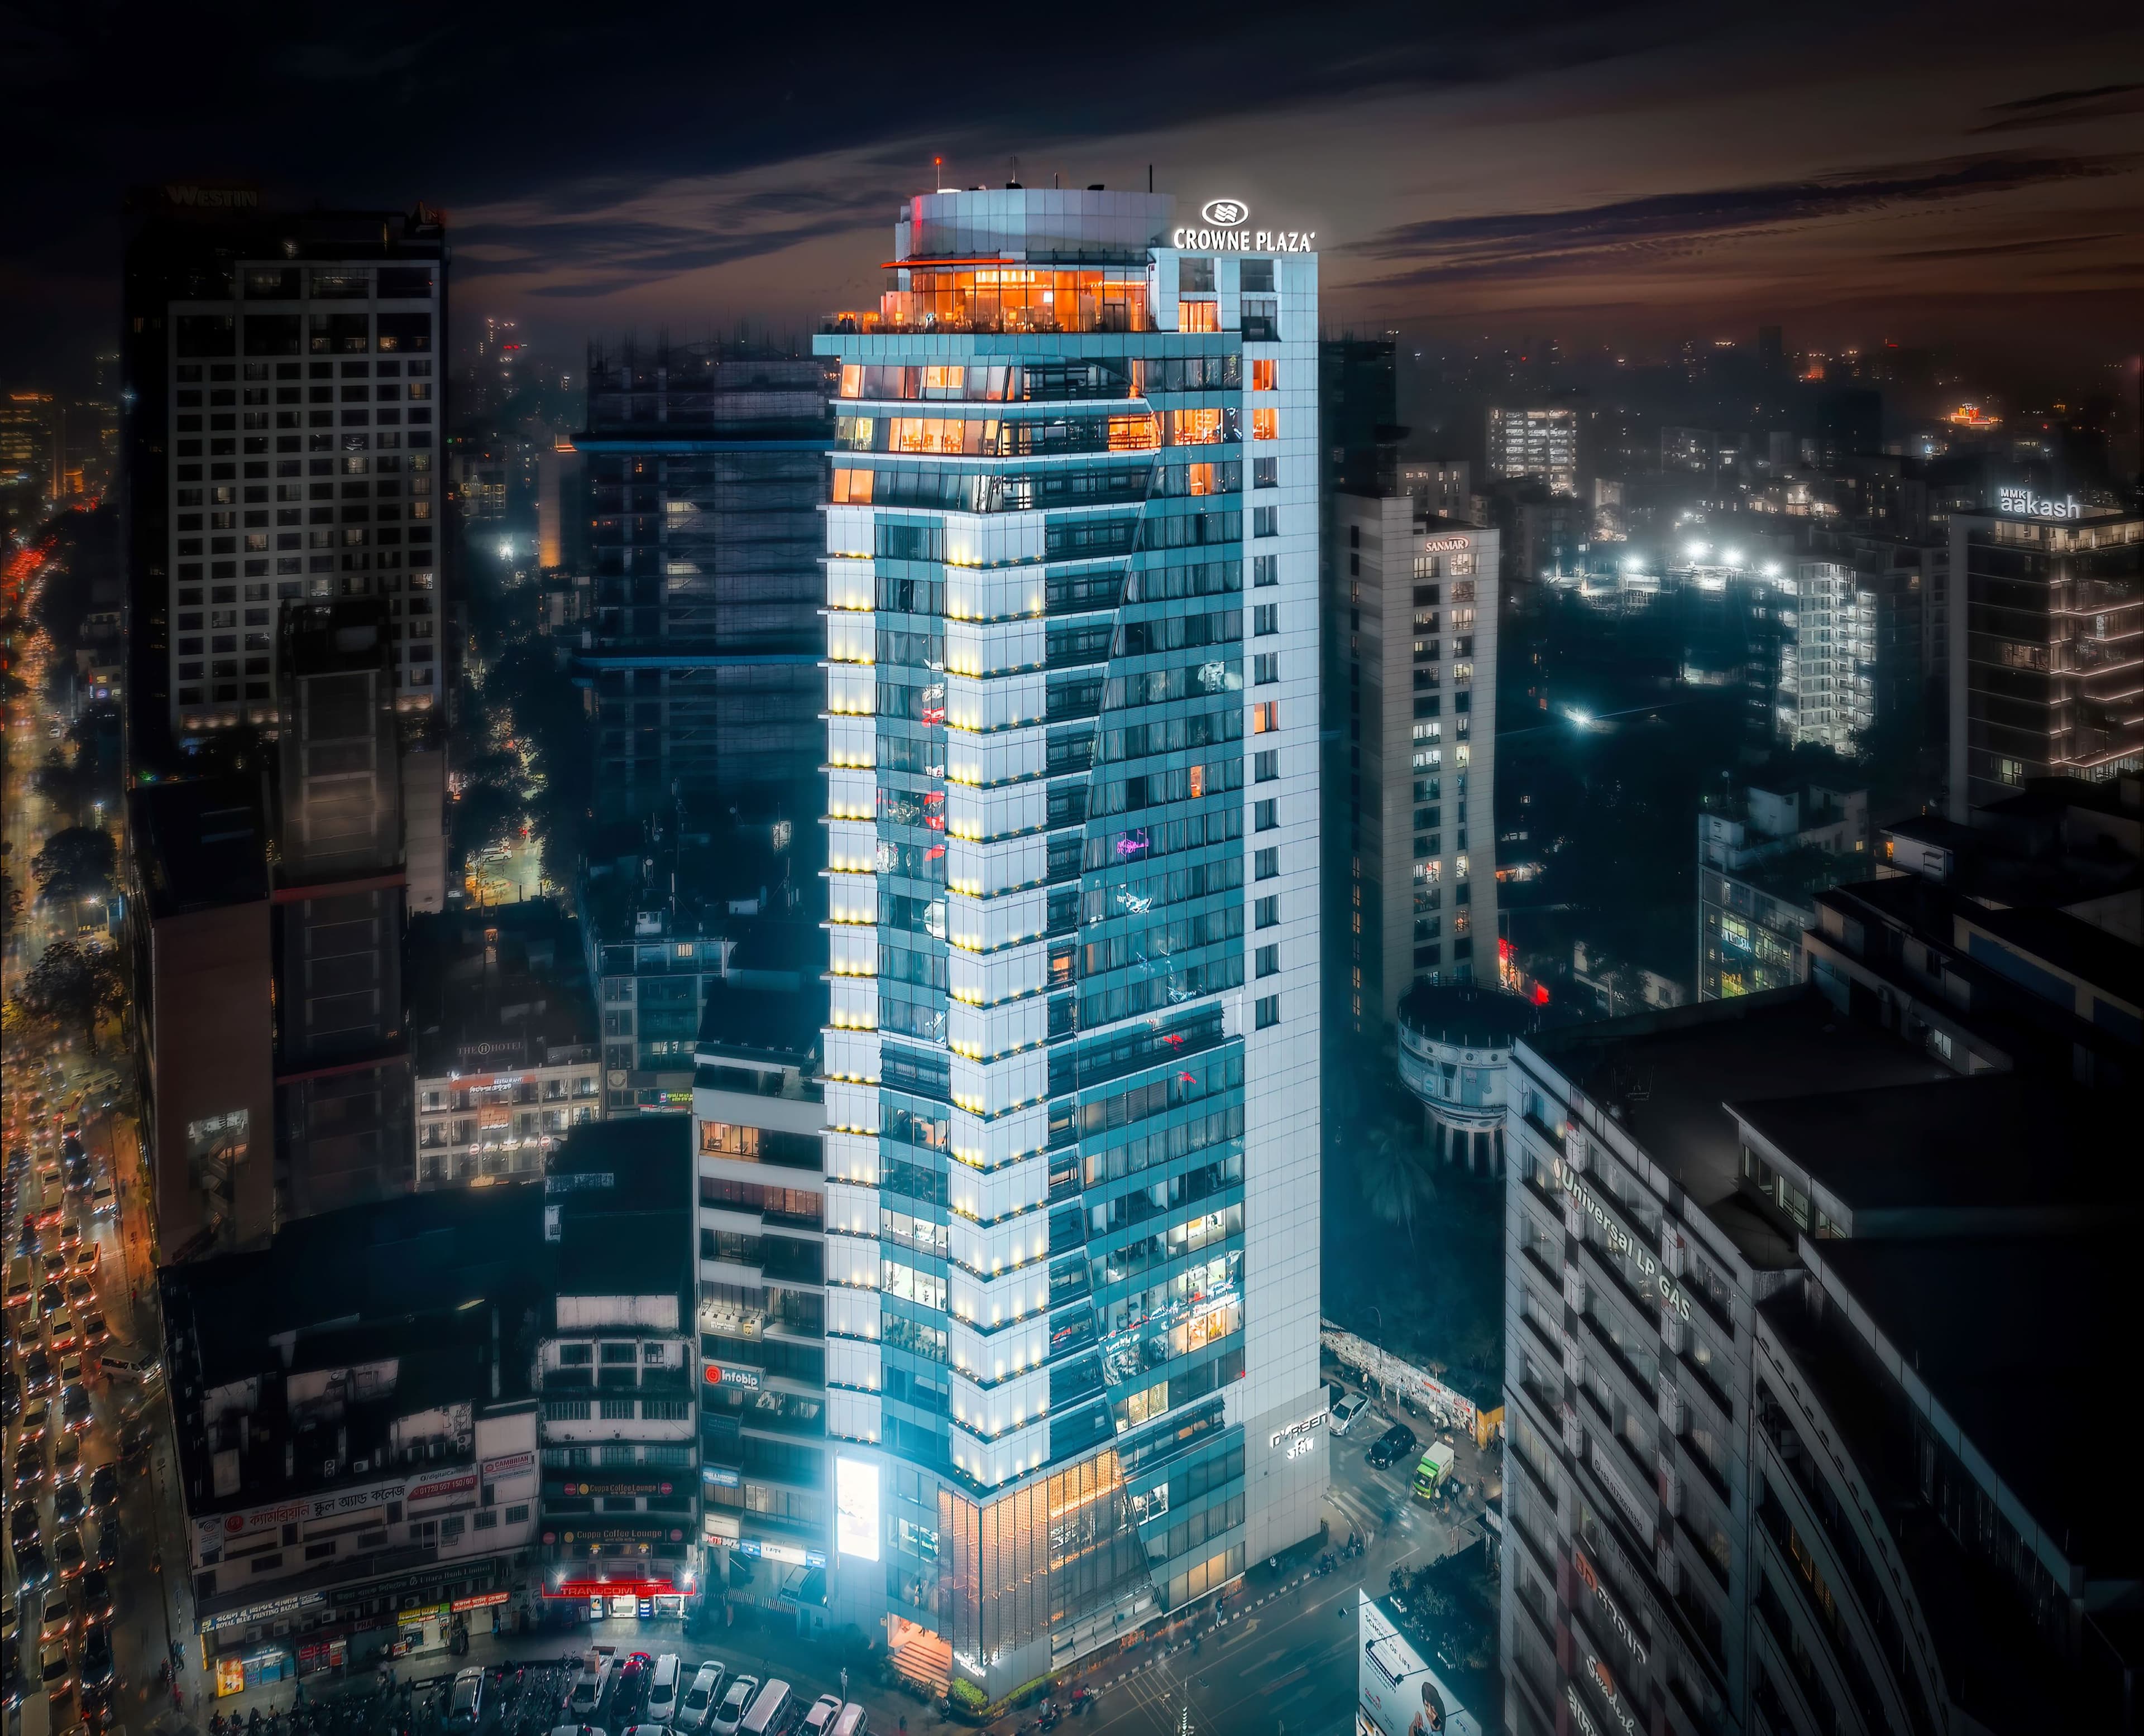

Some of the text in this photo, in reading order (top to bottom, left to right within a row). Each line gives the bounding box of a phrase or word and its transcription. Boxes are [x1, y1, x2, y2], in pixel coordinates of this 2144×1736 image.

[1174, 228, 1311, 252] CROWNE PLAZA
[2001, 491, 2080, 519] aakash
[1425, 539, 1465, 553] SANMAR
[1562, 1163, 1691, 1321] Universal LP GAS
[721, 1369, 758, 1387] Infobip
[495, 1455, 529, 1469] CAMBRIAN
[610, 1483, 631, 1492] Coffee
[632, 1484, 657, 1493] Lounge
[632, 1529, 662, 1538] Lounge
[216, 1619, 236, 1629] ROYAL
[236, 1615, 251, 1625] BLUE
[252, 1609, 279, 1620] PRINTING
[280, 1601, 299, 1613] BAZAR
[1389, 1643, 1398, 1655] OF
[1399, 1653, 1411, 1673] LIFE
